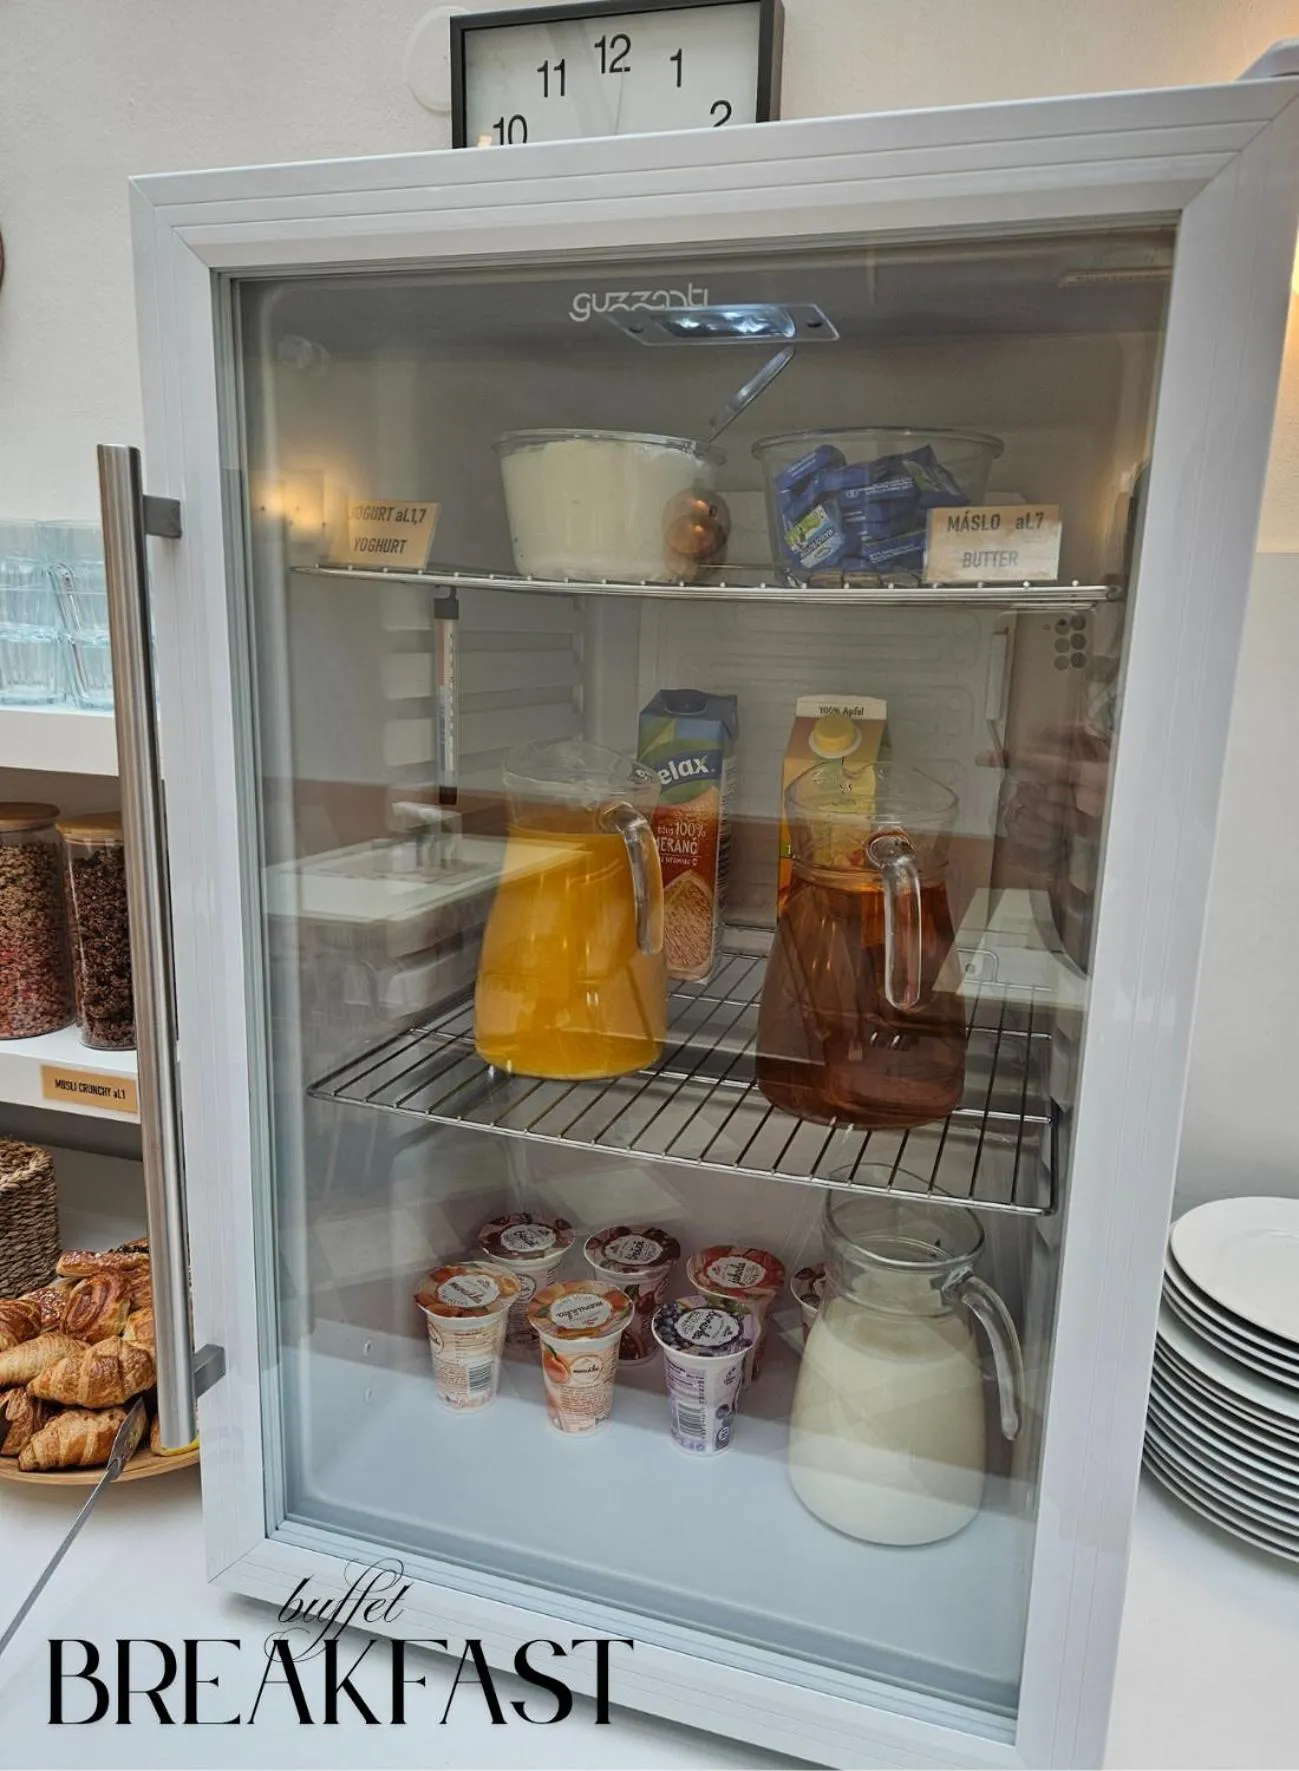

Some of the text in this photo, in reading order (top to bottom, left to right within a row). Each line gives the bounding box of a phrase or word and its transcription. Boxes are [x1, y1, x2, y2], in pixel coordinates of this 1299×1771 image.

[594, 33, 632, 74] 12
[536, 58, 566, 98] 11
[669, 48, 683, 88] 1
[709, 100, 732, 128] 2
[493, 114, 529, 145] 10
[568, 283, 708, 322] guzzanti
[948, 510, 1001, 533] MÁSLO
[353, 537, 408, 554] YOGHURT
[961, 550, 1019, 568] BUTTER
[842, 706, 864, 717] Apfel
[658, 755, 709, 785] elax
[675, 821, 706, 839] 100%
[79, 1082, 112, 1097] CRUNCHY
